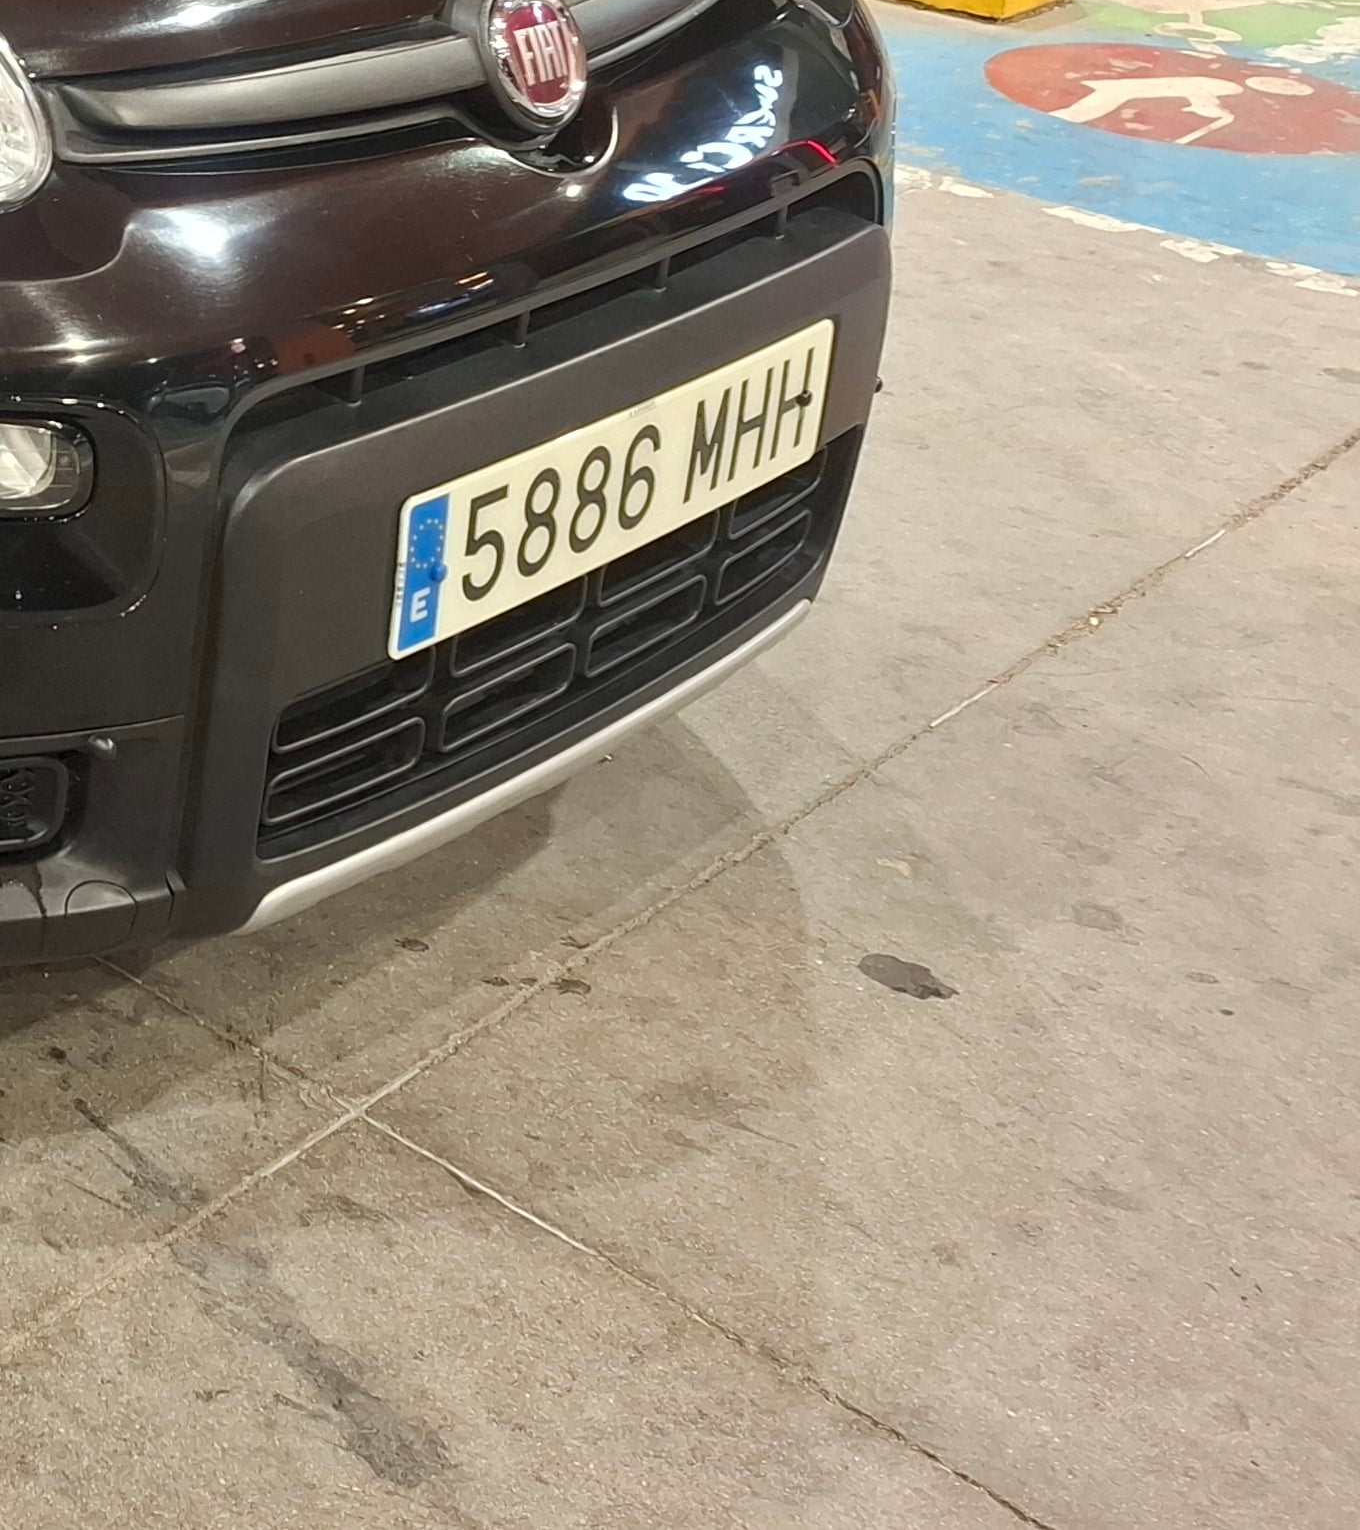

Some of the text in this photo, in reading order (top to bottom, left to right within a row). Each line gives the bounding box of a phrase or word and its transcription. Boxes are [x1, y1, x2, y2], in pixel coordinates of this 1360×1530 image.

[513, 19, 569, 87] FIAT
[461, 346, 815, 602] 5886 MHH
[409, 587, 430, 622] E
